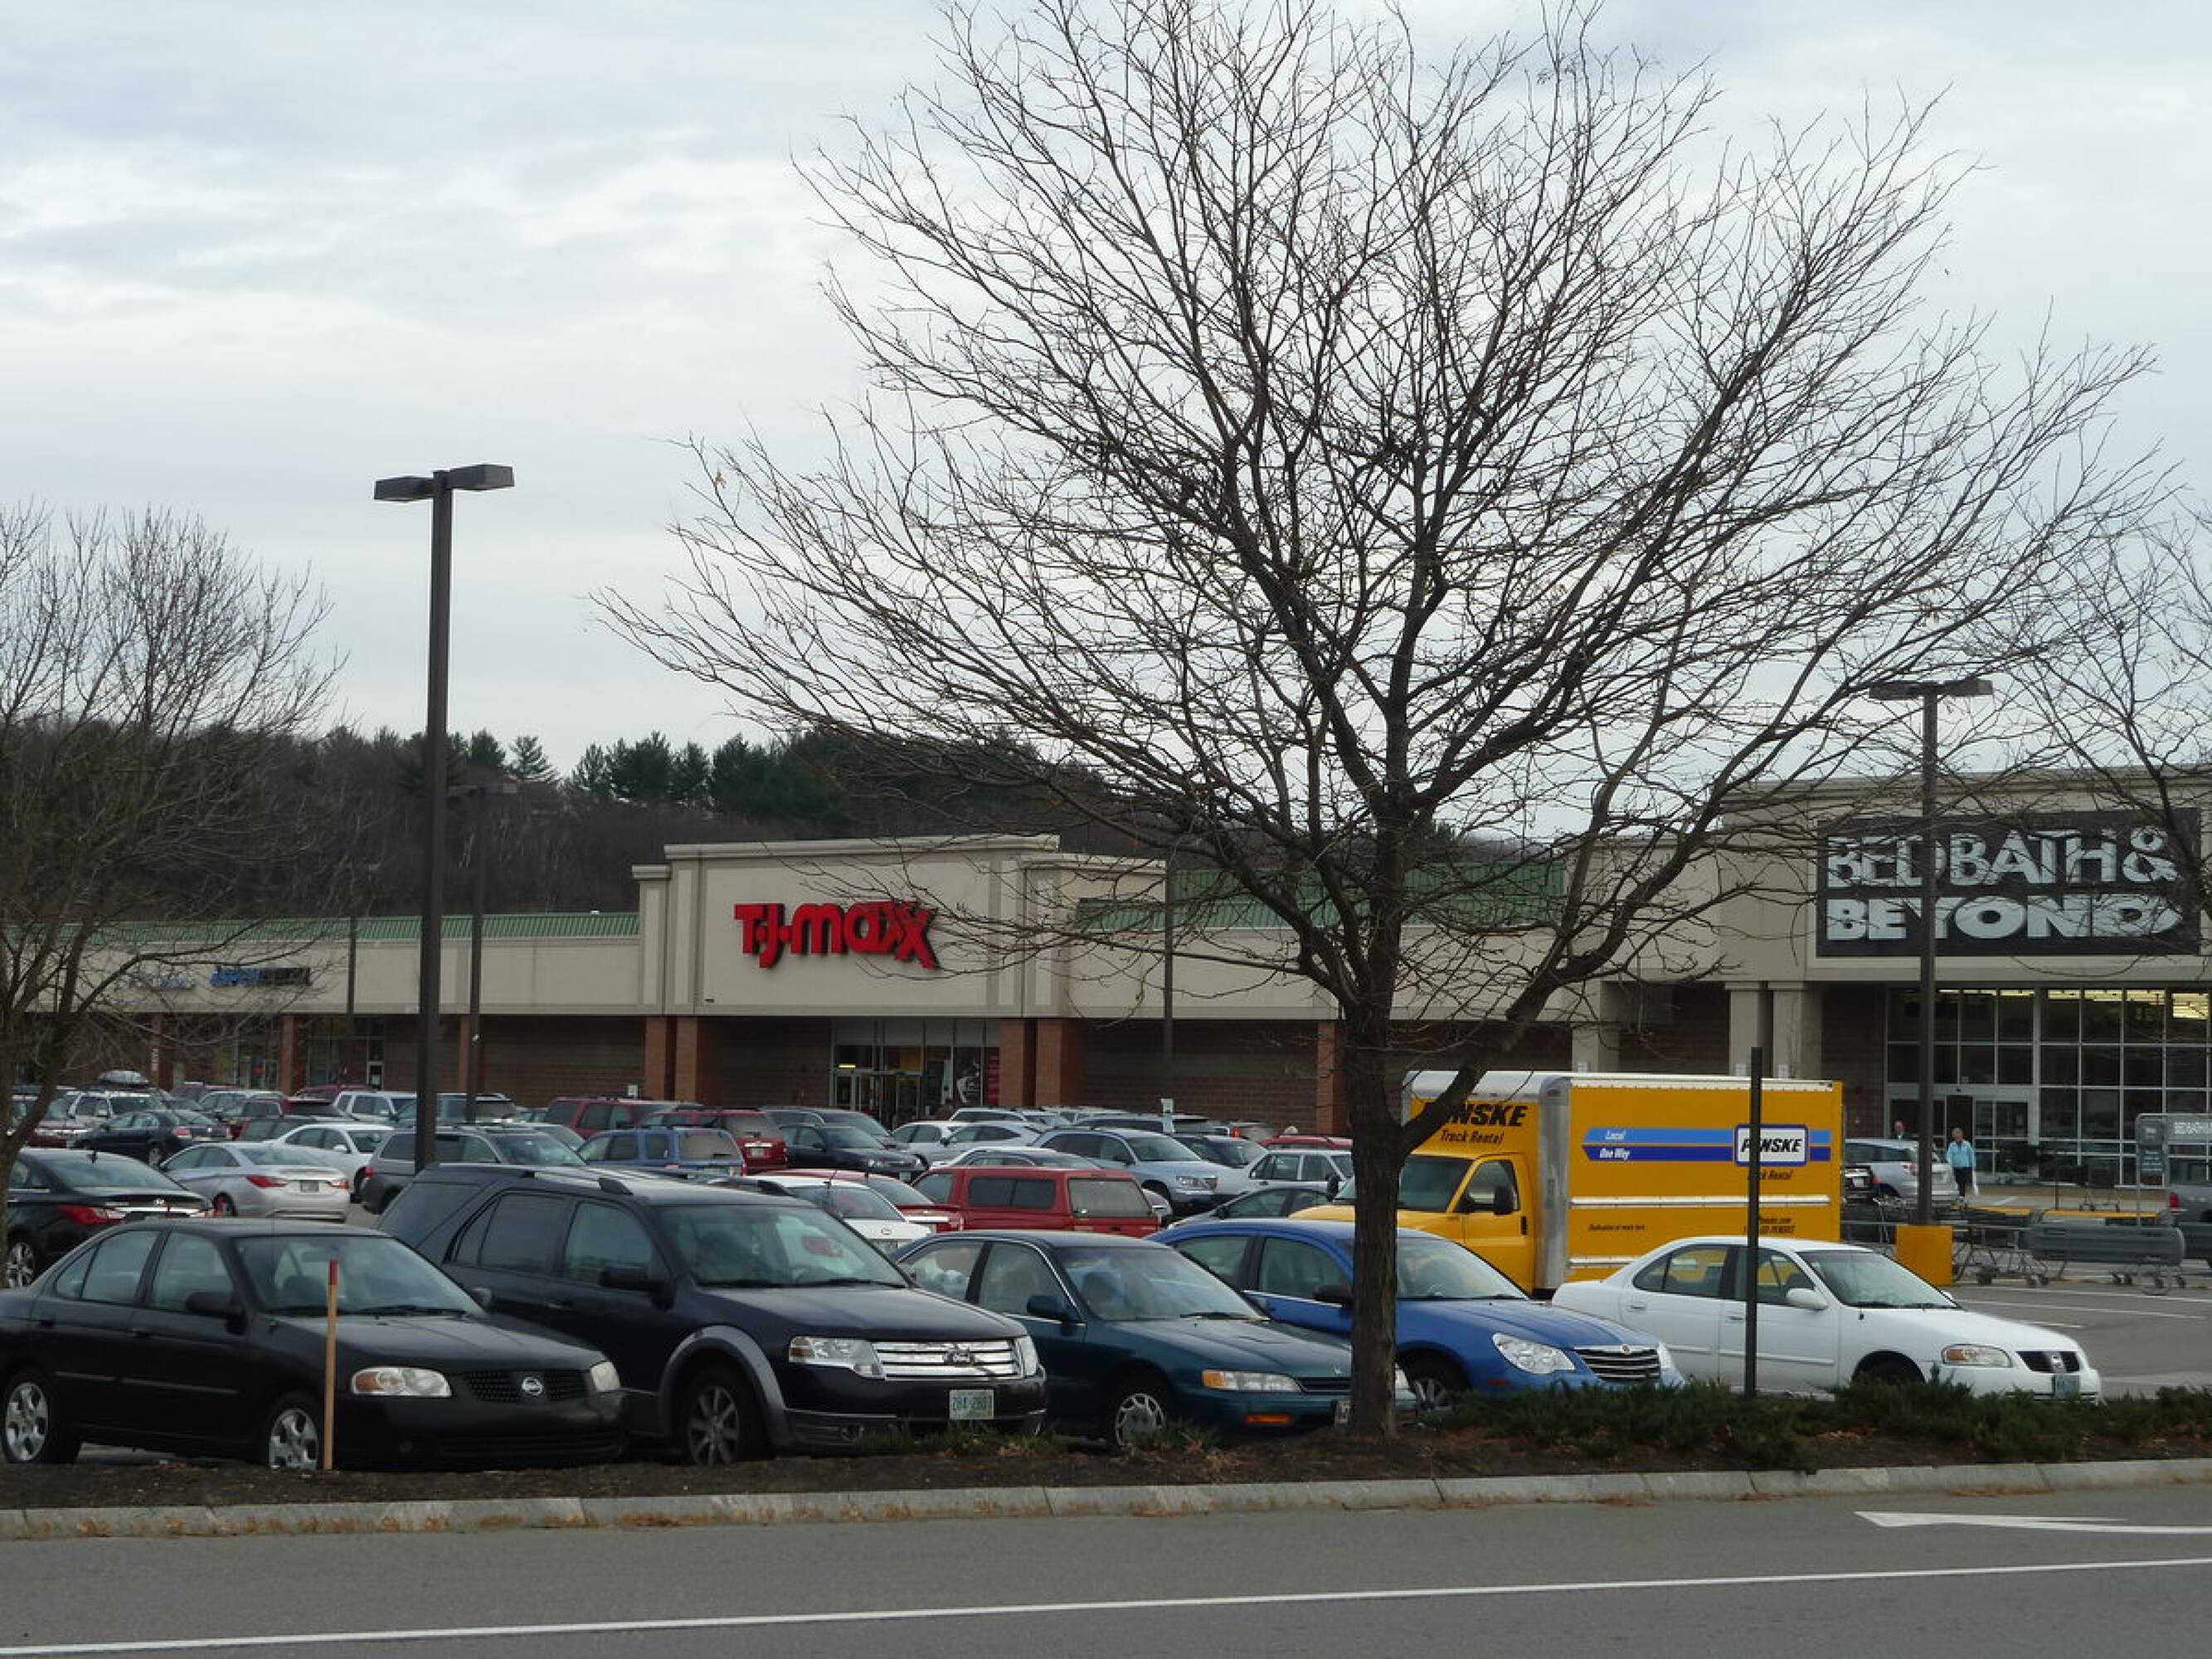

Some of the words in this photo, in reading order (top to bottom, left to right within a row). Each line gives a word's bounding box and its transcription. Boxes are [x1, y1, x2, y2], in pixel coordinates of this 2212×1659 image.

[1827, 834, 1947, 888] BED
[1950, 830, 2117, 886] BATH
[2122, 827, 2180, 883] &
[1826, 894, 2183, 939] BEYOND
[1423, 1102, 1529, 1127] NSKE
[1440, 1129, 1467, 1142] Truck
[1471, 1131, 1505, 1146] Rental
[1741, 1138, 1803, 1153] PNSKE
